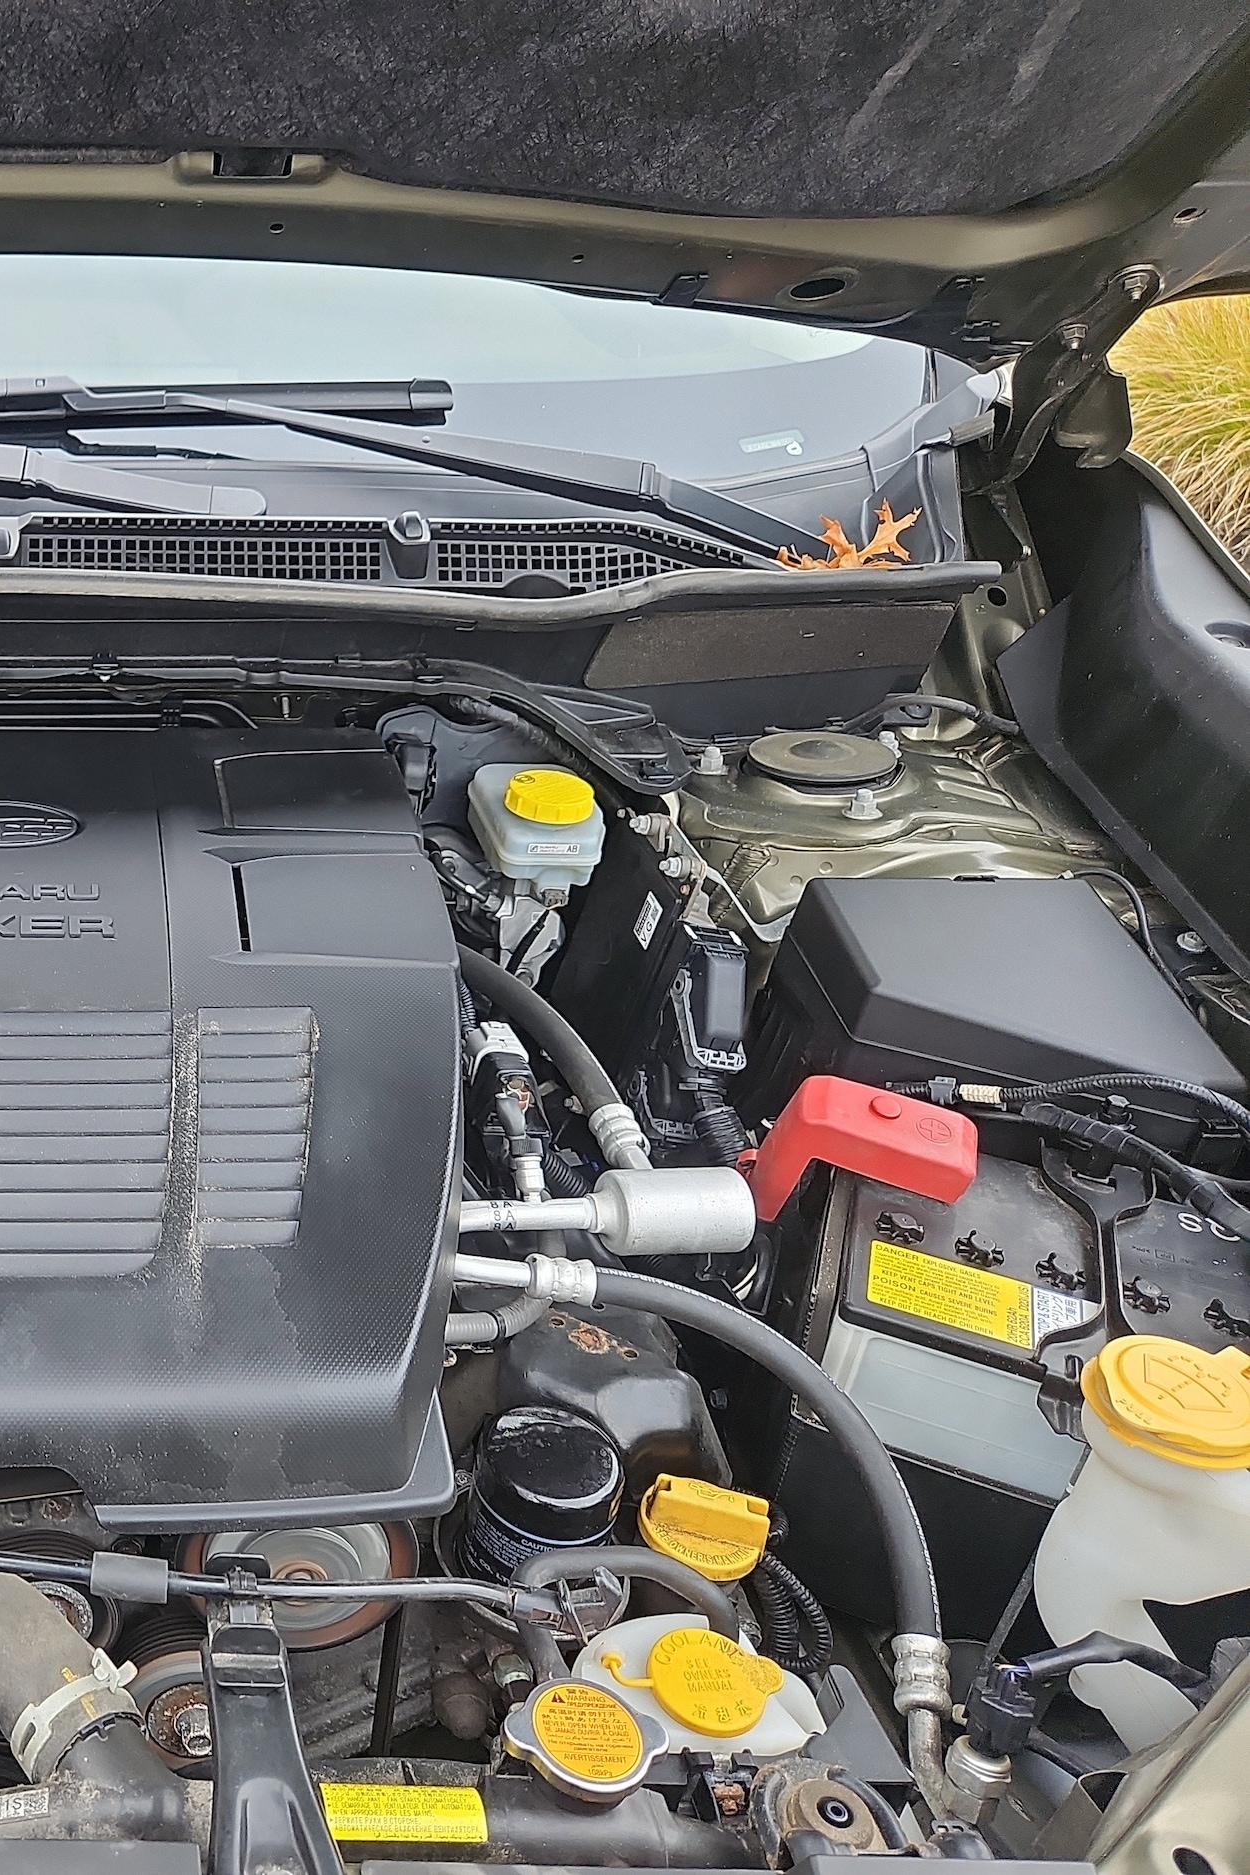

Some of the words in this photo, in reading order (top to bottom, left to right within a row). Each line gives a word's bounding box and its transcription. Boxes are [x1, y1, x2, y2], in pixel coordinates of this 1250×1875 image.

[566, 845, 578, 853] AB
[875, 1244, 919, 1261] DANGER
[922, 1258, 958, 1272] EXPLOSIVE
[959, 1268, 981, 1280] GASES
[873, 1274, 916, 1292] POISON
[919, 1289, 946, 1301] CAUSES
[948, 1297, 972, 1309] SEVERE
[974, 1305, 997, 1316] BURNS
[882, 1269, 898, 1277] KEEP
[899, 1274, 916, 1284] VENT
[918, 1280, 936, 1290] CAPS
[938, 1285, 957, 1296] TIGHT
[958, 1290, 973, 1300] AND
[974, 1295, 996, 1307] LEVEL
[1037, 1290, 1050, 1313] START
[880, 1297, 896, 1306] KEEP
[897, 1302, 912, 1310] OUT
[923, 1310, 947, 1321] REACH
[948, 1316, 956, 1324] OF
[958, 1320, 994, 1335] CHILDREN
[1018, 1331, 1030, 1346] CCA
[520, 1538, 556, 1553] CAUTIO
[653, 1525, 674, 1542] SEE
[669, 1541, 713, 1565] OWNER'S
[712, 1547, 753, 1566] MANUAL
[654, 1631, 745, 1666] COOLANT
[685, 1658, 710, 1669] SEE
[683, 1668, 731, 1682] OWNERS
[686, 1680, 737, 1693] MANUAL
[565, 1694, 606, 1703] WARNING
[543, 1720, 566, 1728] NEVER
[568, 1721, 587, 1729] OPEN
[554, 1727, 576, 1735] JAMAIS
[577, 1728, 601, 1736] OUVRIR
[563, 1753, 627, 1764] AVERTISSEMENT
